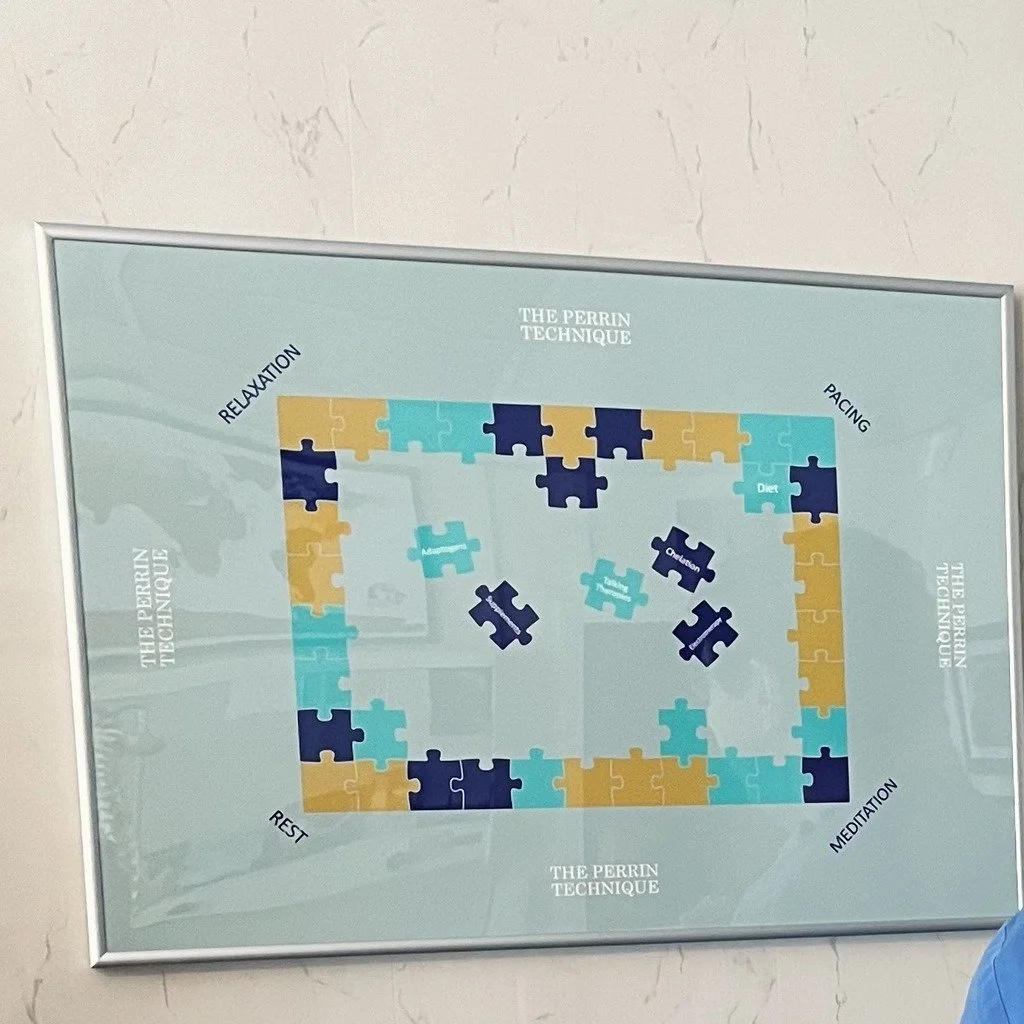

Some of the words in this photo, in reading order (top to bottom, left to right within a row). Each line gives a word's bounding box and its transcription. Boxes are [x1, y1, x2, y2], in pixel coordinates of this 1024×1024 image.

[519, 307, 558, 323] THE
[562, 309, 631, 327] PERRIN
[520, 325, 632, 347] TECHNIQUE
[218, 343, 301, 424] RELAXATION
[823, 383, 871, 433] PACING
[757, 482, 779, 494] Diet
[665, 547, 701, 573] Chelation
[132, 547, 153, 622] PERRIN
[950, 562, 965, 599] THE
[151, 548, 176, 667] TECHNIQUE
[936, 562, 952, 669] TECHNIQUE
[138, 626, 156, 668] THE
[953, 603, 967, 669] PERRIN
[269, 809, 309, 844] REST
[829, 778, 898, 854] MEDITATION
[550, 865, 588, 880] THE
[593, 863, 659, 879] PERRIN
[551, 880, 660, 897] TECHNIQUE
